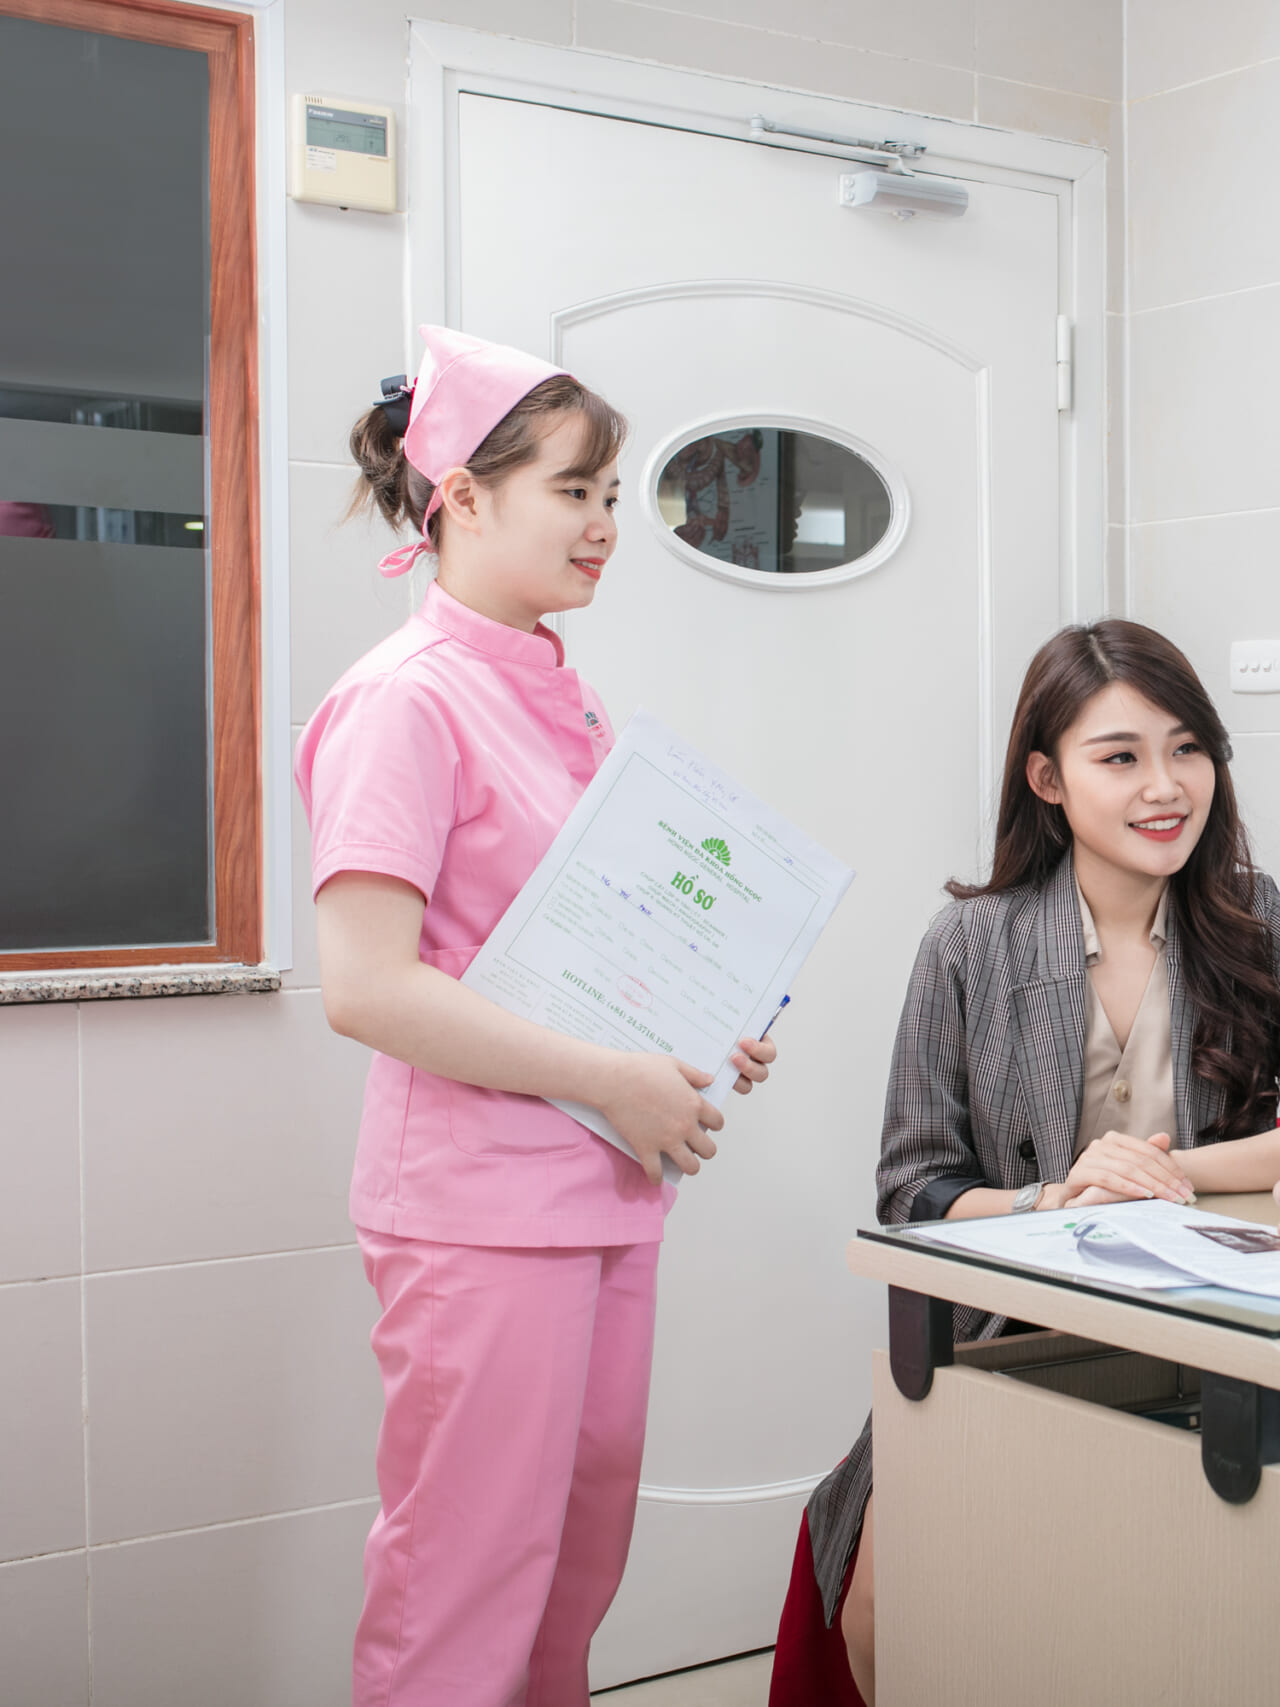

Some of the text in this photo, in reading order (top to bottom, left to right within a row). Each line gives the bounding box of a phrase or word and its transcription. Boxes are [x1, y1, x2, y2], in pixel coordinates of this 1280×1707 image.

[668, 863, 718, 913] HỒ SƠ
[560, 967, 608, 1005] HOTLINE:
